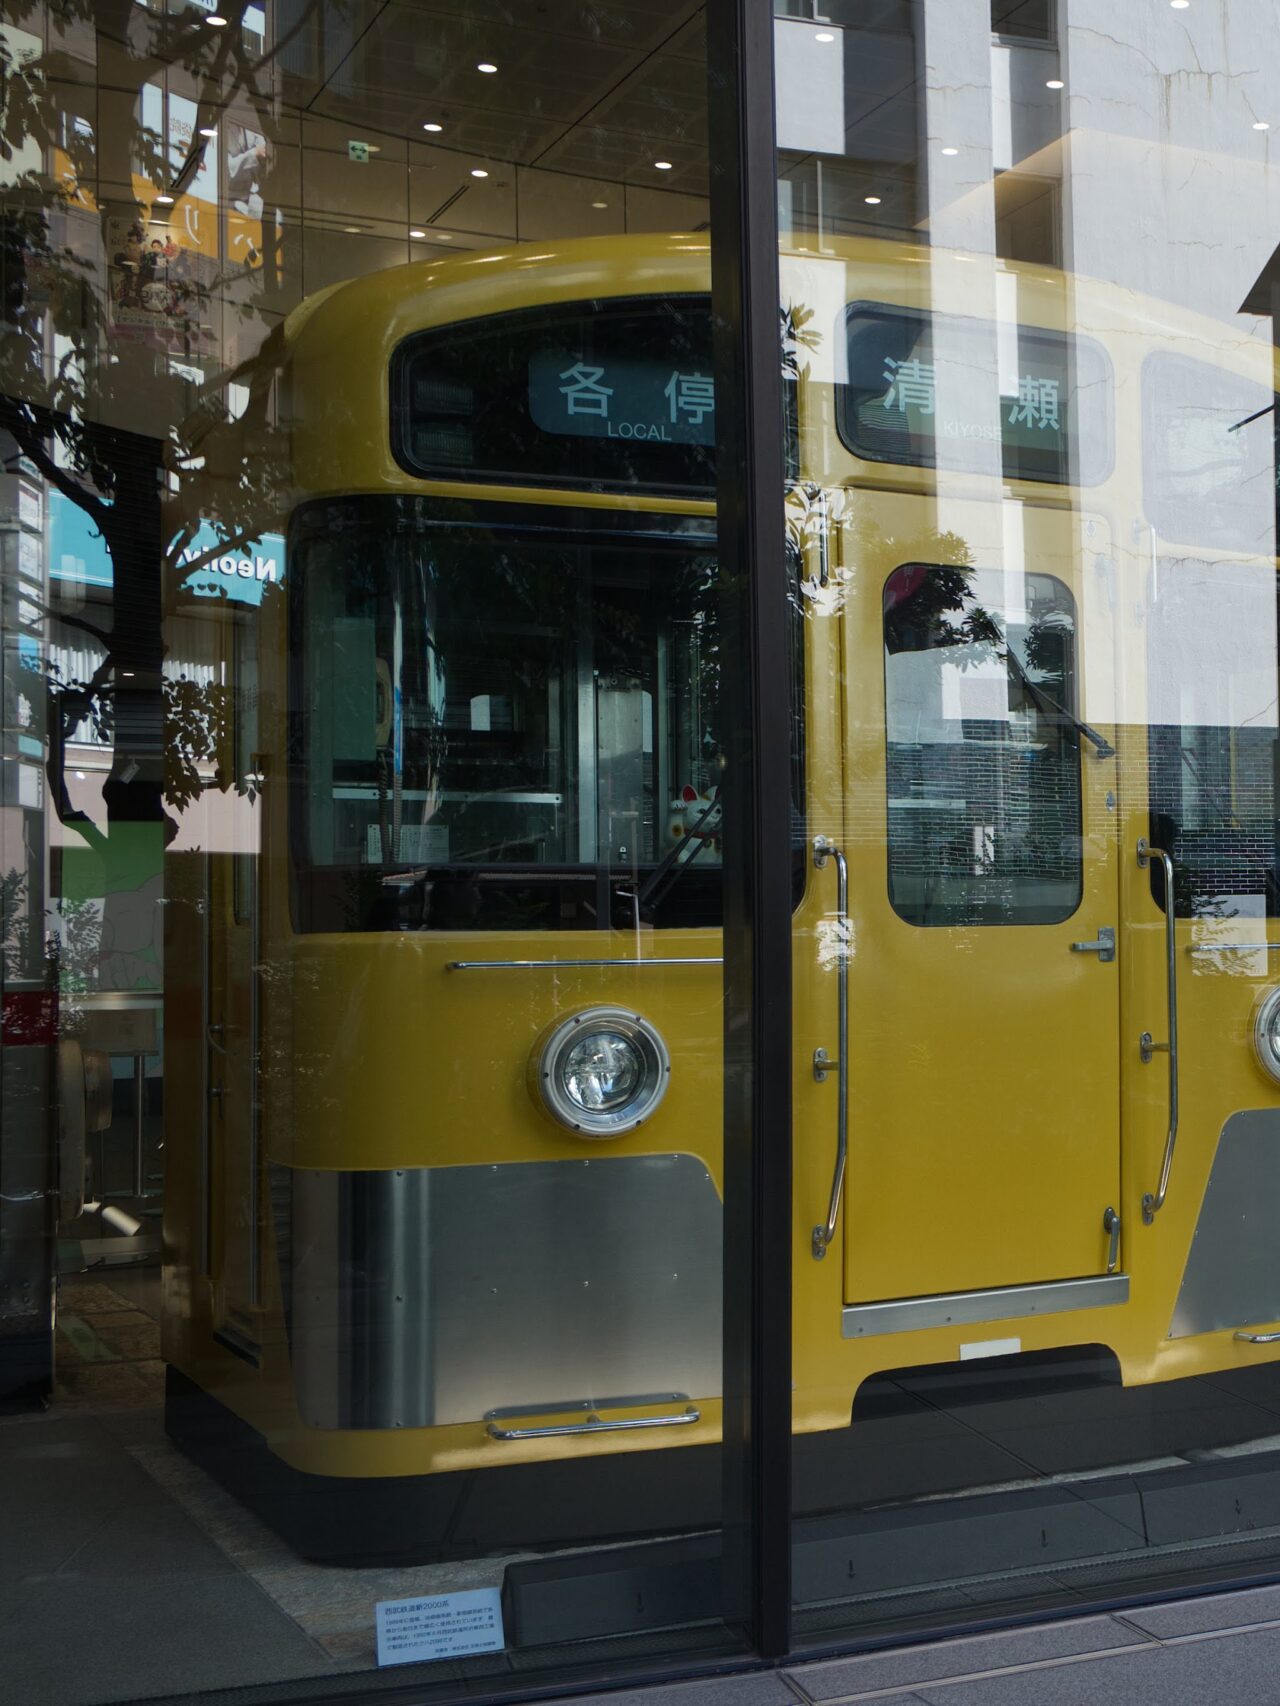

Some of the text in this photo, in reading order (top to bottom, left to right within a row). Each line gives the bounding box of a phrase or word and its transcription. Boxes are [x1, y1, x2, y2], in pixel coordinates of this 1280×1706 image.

[558, 362, 716, 424] 各停
[881, 356, 1061, 432] 清瀬
[607, 421, 672, 441] LOCAL
[943, 420, 1003, 441] KIYOSE
